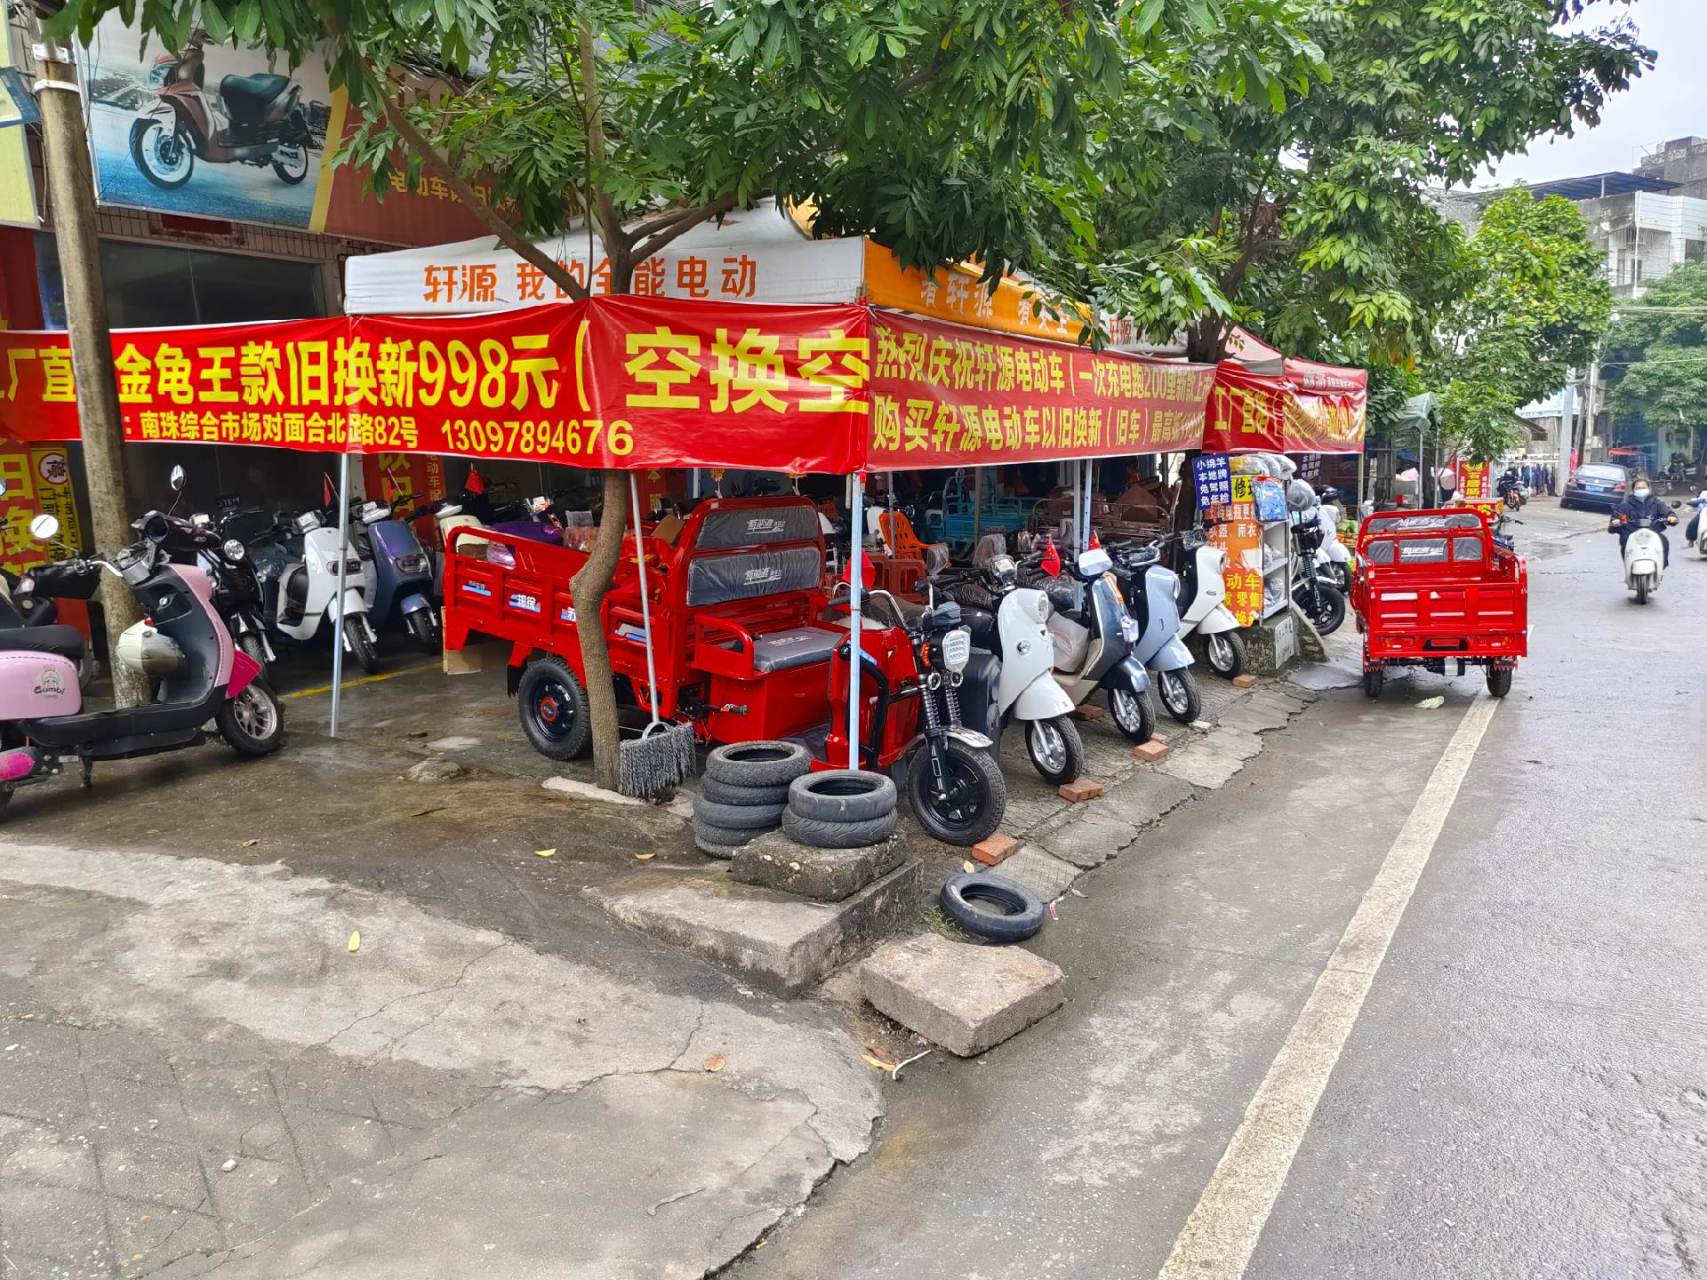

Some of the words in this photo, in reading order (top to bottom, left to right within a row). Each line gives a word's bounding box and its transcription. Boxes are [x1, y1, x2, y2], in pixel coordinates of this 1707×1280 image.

[422, 264, 497, 303] 轩源
[441, 418, 634, 456] 13097894676
[1196, 457, 1227, 471] 小绵羊
